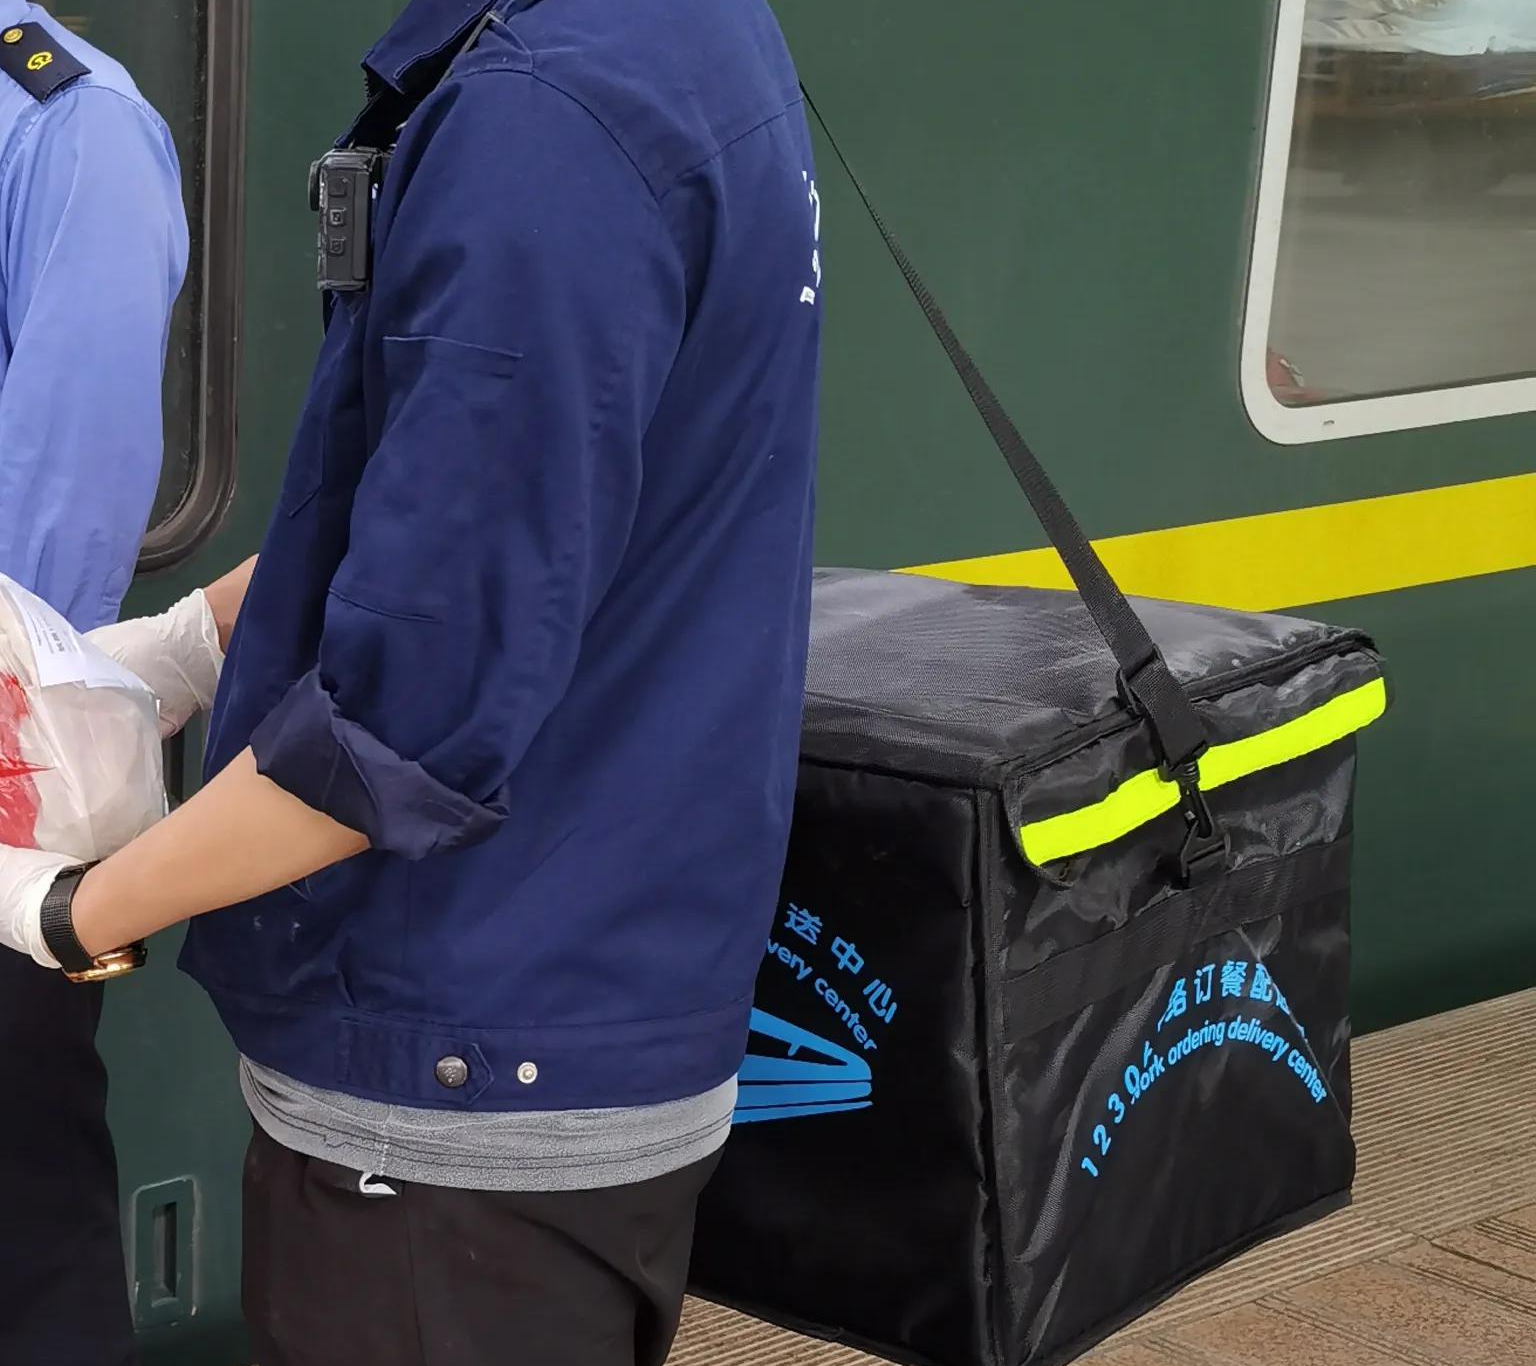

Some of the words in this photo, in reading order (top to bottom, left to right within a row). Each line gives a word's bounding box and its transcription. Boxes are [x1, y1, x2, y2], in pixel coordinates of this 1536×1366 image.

[784, 902, 898, 1024] 送中心
[815, 978, 878, 1050] center
[1168, 1021, 1226, 1066] ordering
[1227, 1015, 1290, 1062] delivery
[1287, 1049, 1328, 1104] center
